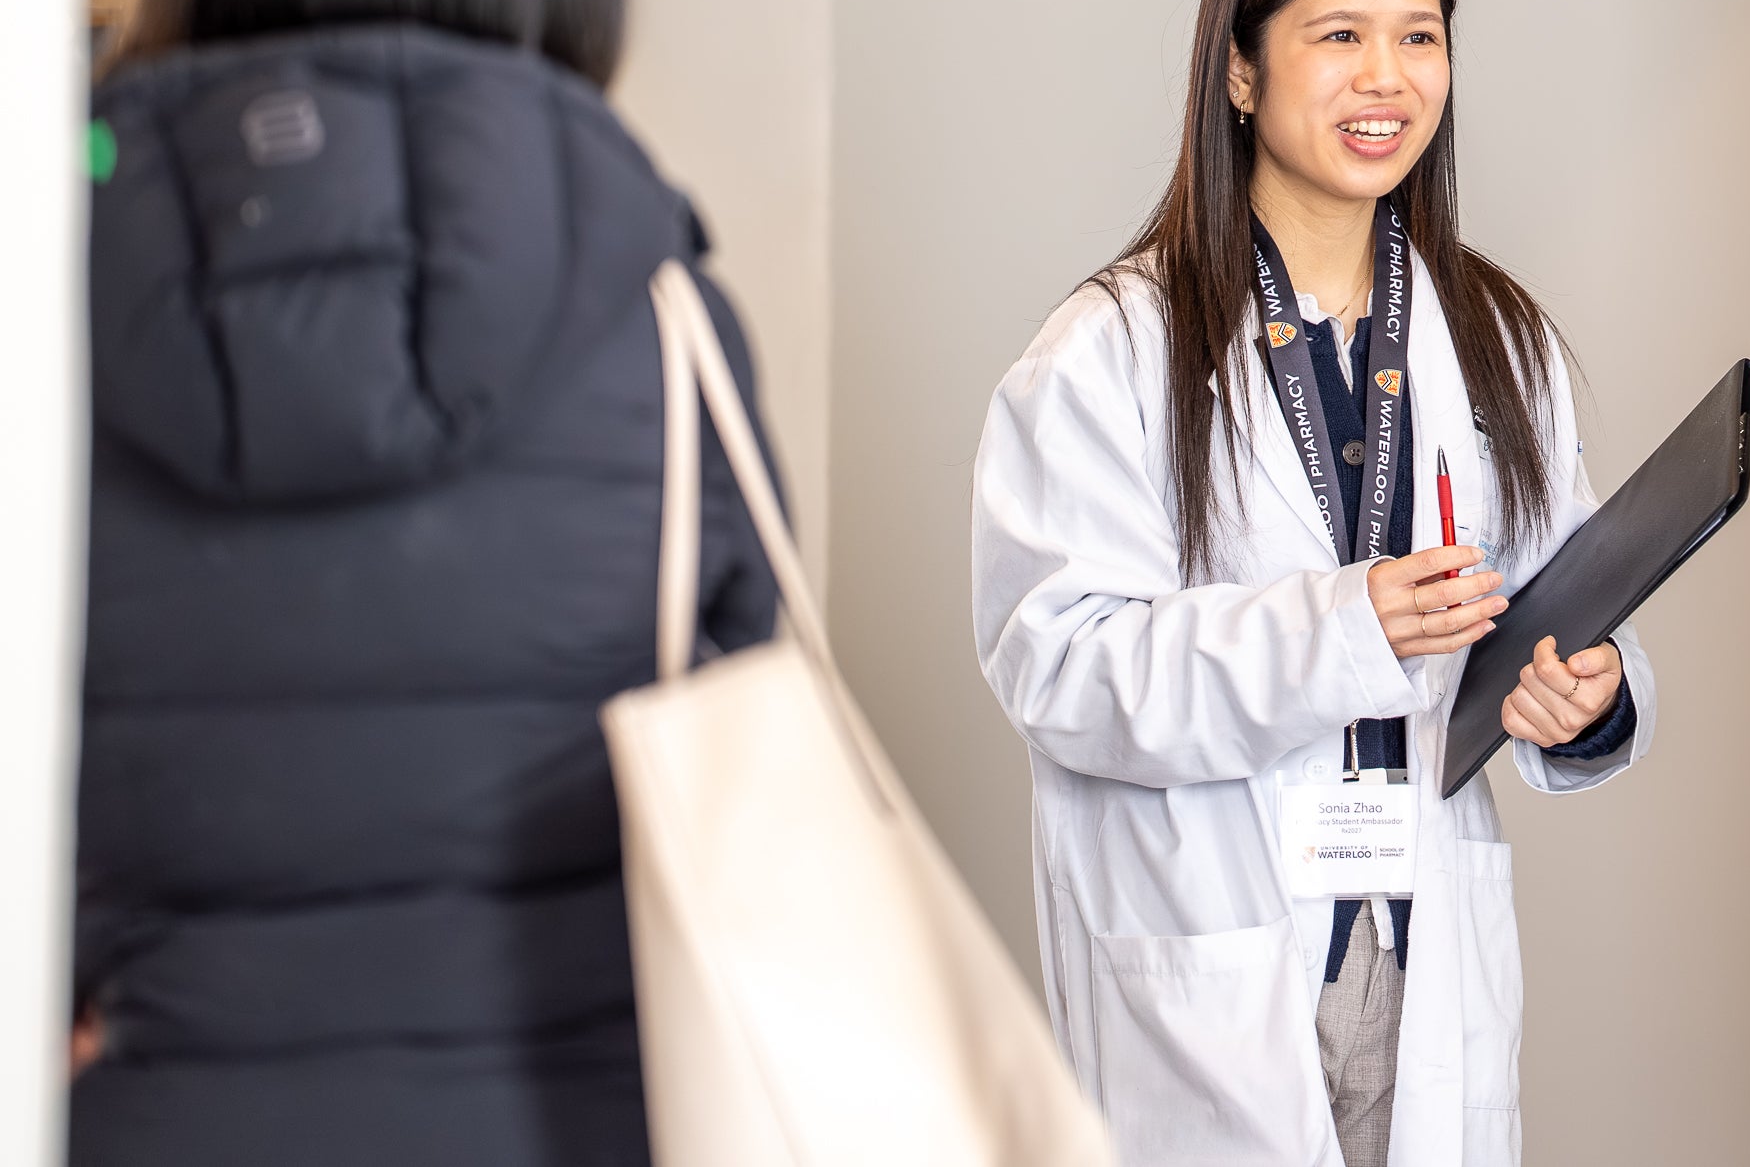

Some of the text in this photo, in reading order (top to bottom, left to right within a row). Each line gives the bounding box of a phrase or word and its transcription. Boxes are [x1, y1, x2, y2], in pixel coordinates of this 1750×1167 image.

[1386, 242, 1403, 344] PHARMACY
[1286, 373, 1323, 477] PHARMACY
[1374, 400, 1393, 505] WATERLOO
[1317, 850, 1372, 859] WATERLOO
[1318, 802, 1383, 814] Sonia Zhao
